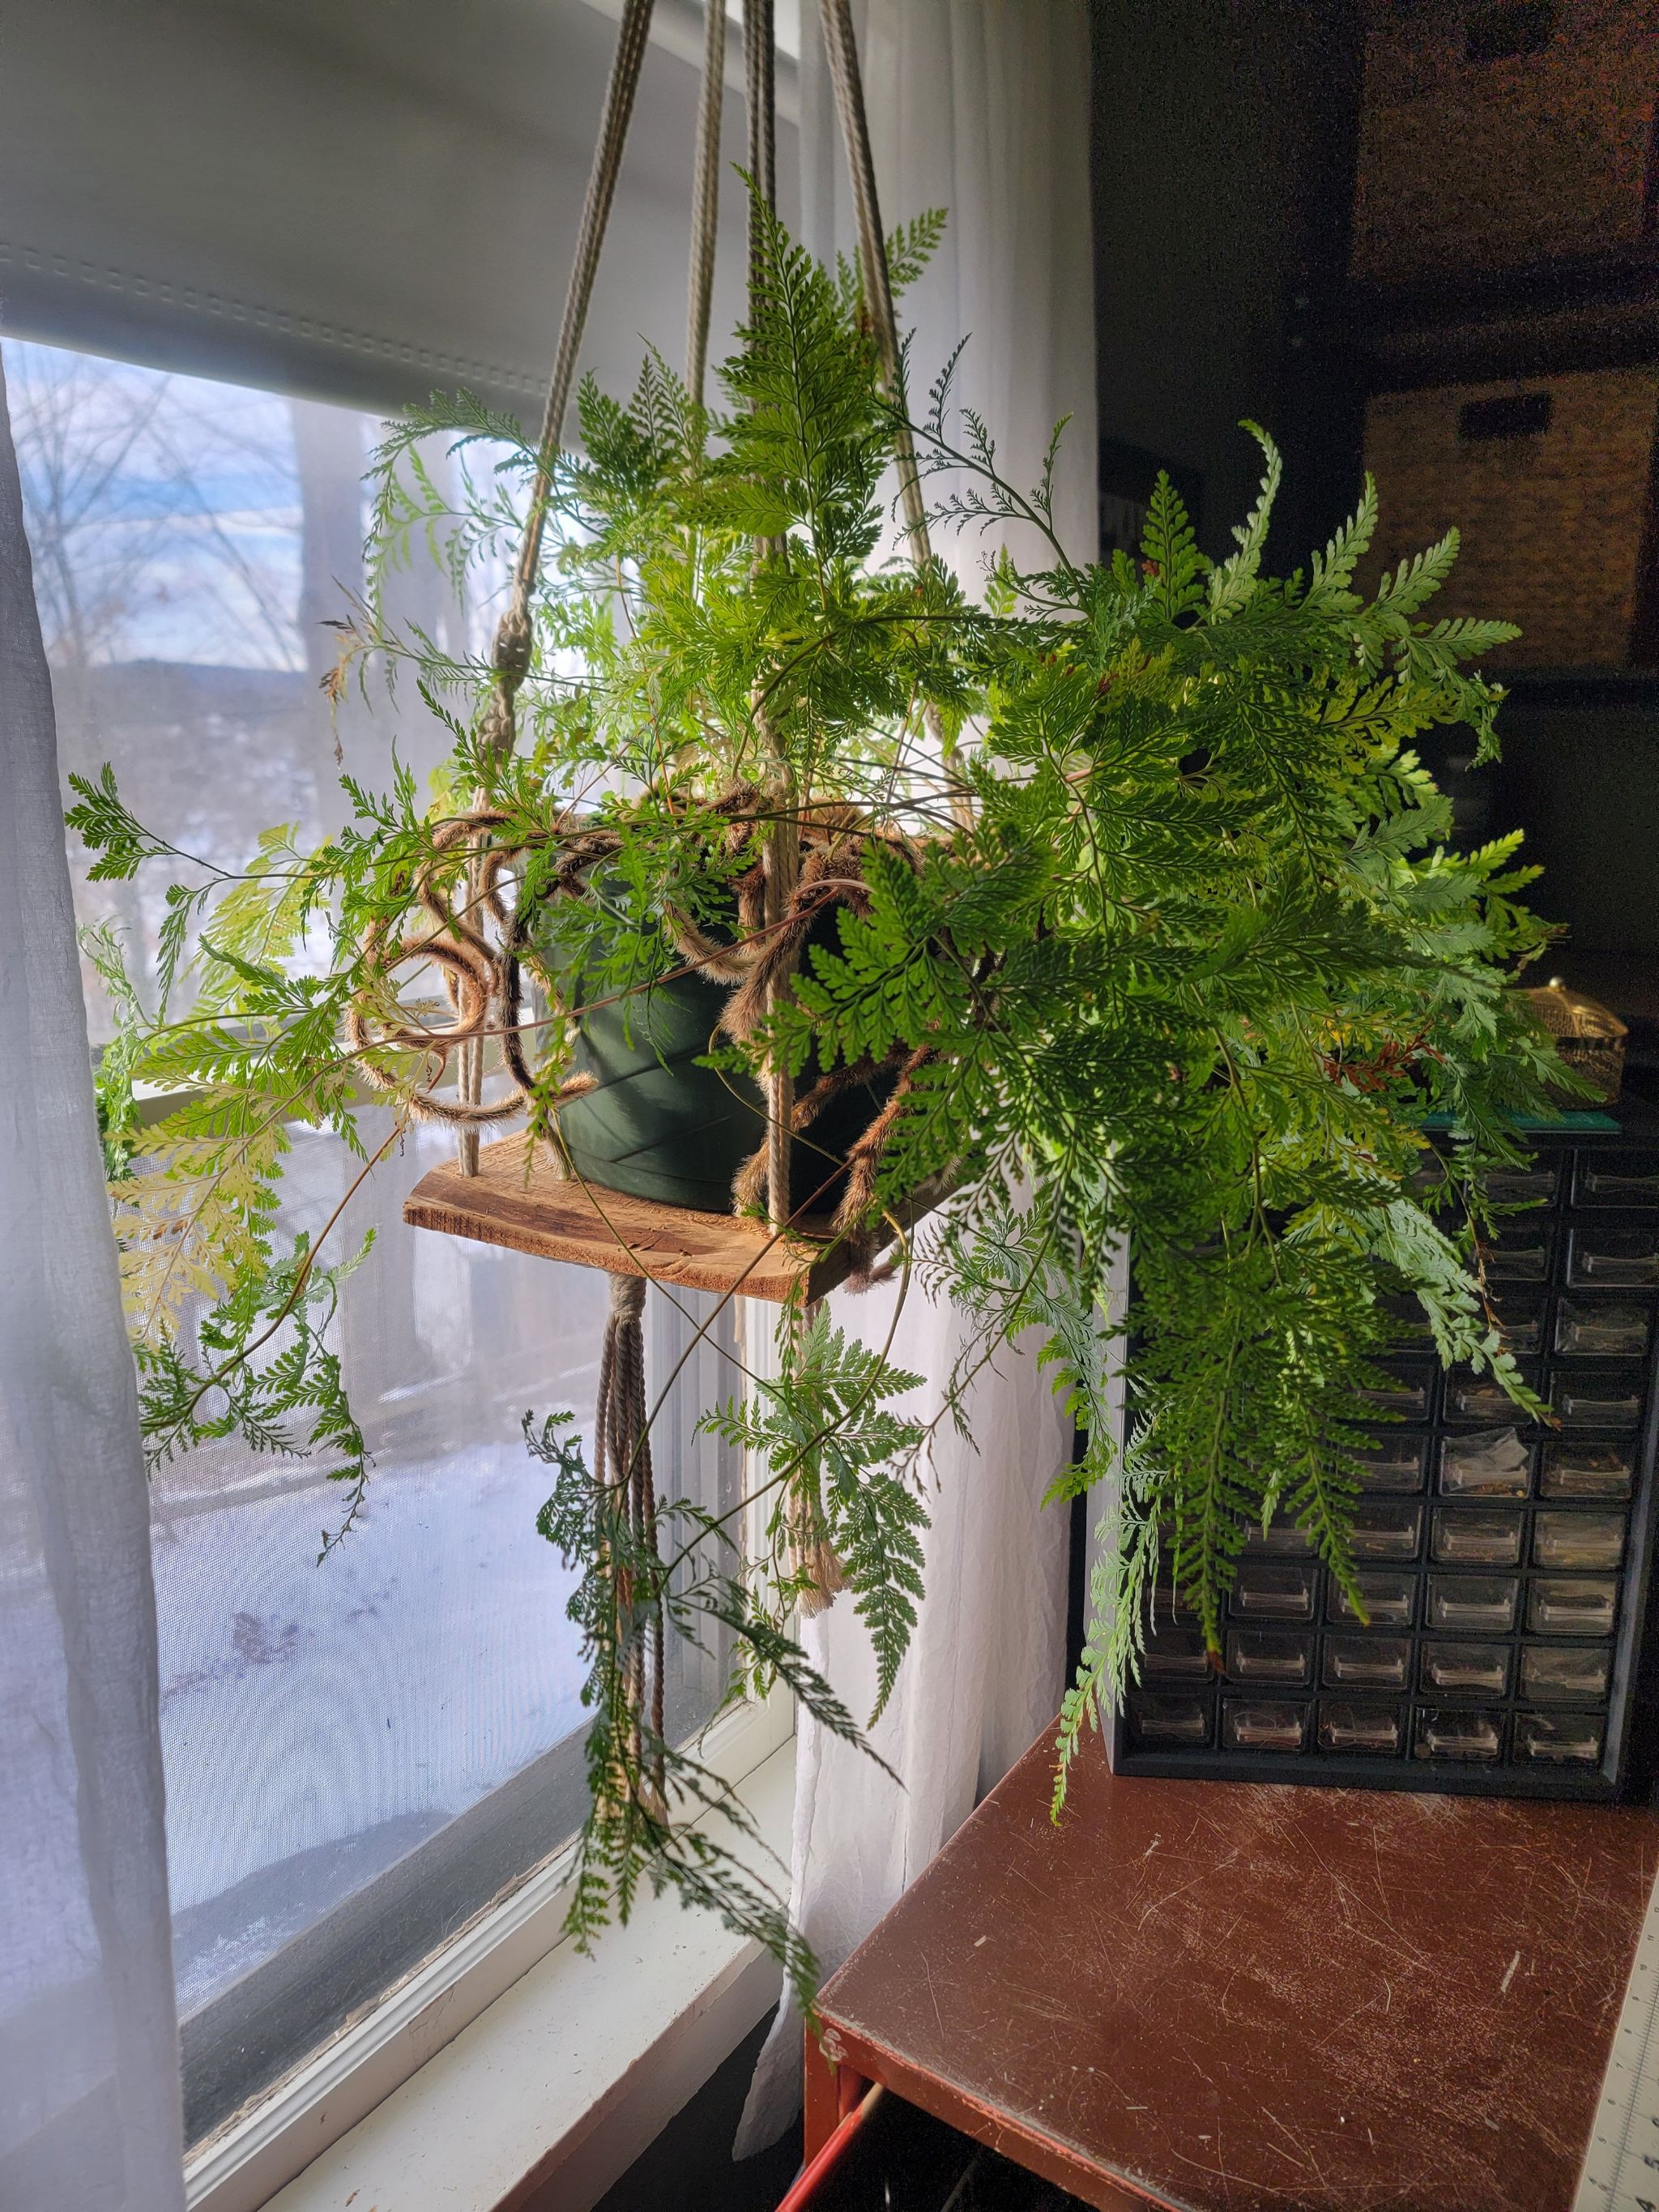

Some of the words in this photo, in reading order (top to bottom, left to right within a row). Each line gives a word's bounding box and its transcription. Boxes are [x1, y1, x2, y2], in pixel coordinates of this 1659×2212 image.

[1597, 2135, 1607, 2145] 5
[1639, 1963, 1648, 1971] 10
[1635, 2196, 1658, 2212] 4
